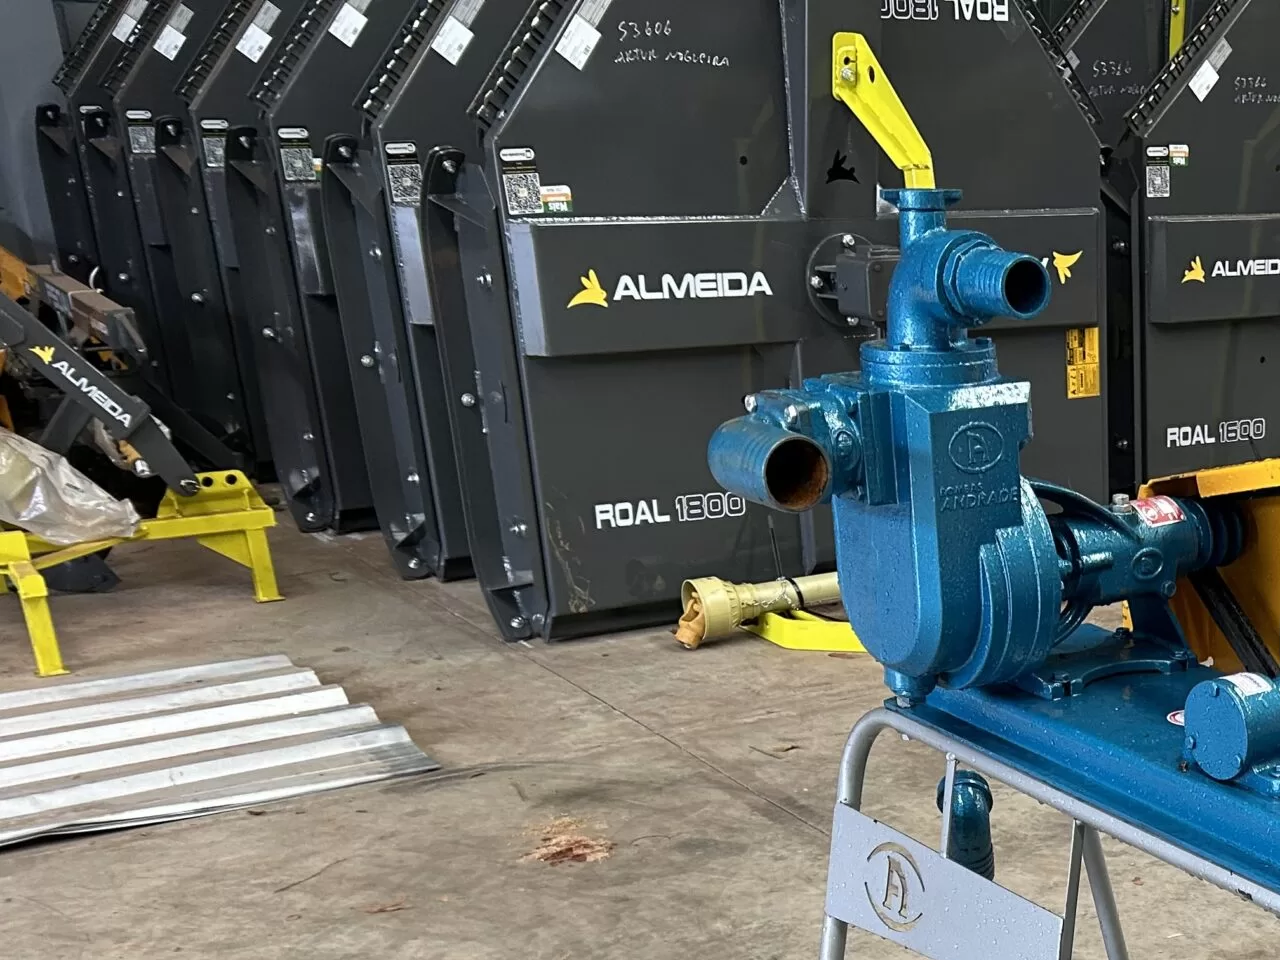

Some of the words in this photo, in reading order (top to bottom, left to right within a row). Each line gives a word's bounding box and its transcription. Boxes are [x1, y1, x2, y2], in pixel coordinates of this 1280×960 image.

[944, 0, 1009, 22] ROAL
[612, 271, 774, 302] ALMEIDA
[51, 360, 132, 428] ALMEIDA
[1167, 424, 1216, 448] ROAL
[594, 498, 671, 530] ROAL
[675, 491, 746, 522] 1800
[940, 486, 1018, 512] ANDRADE
